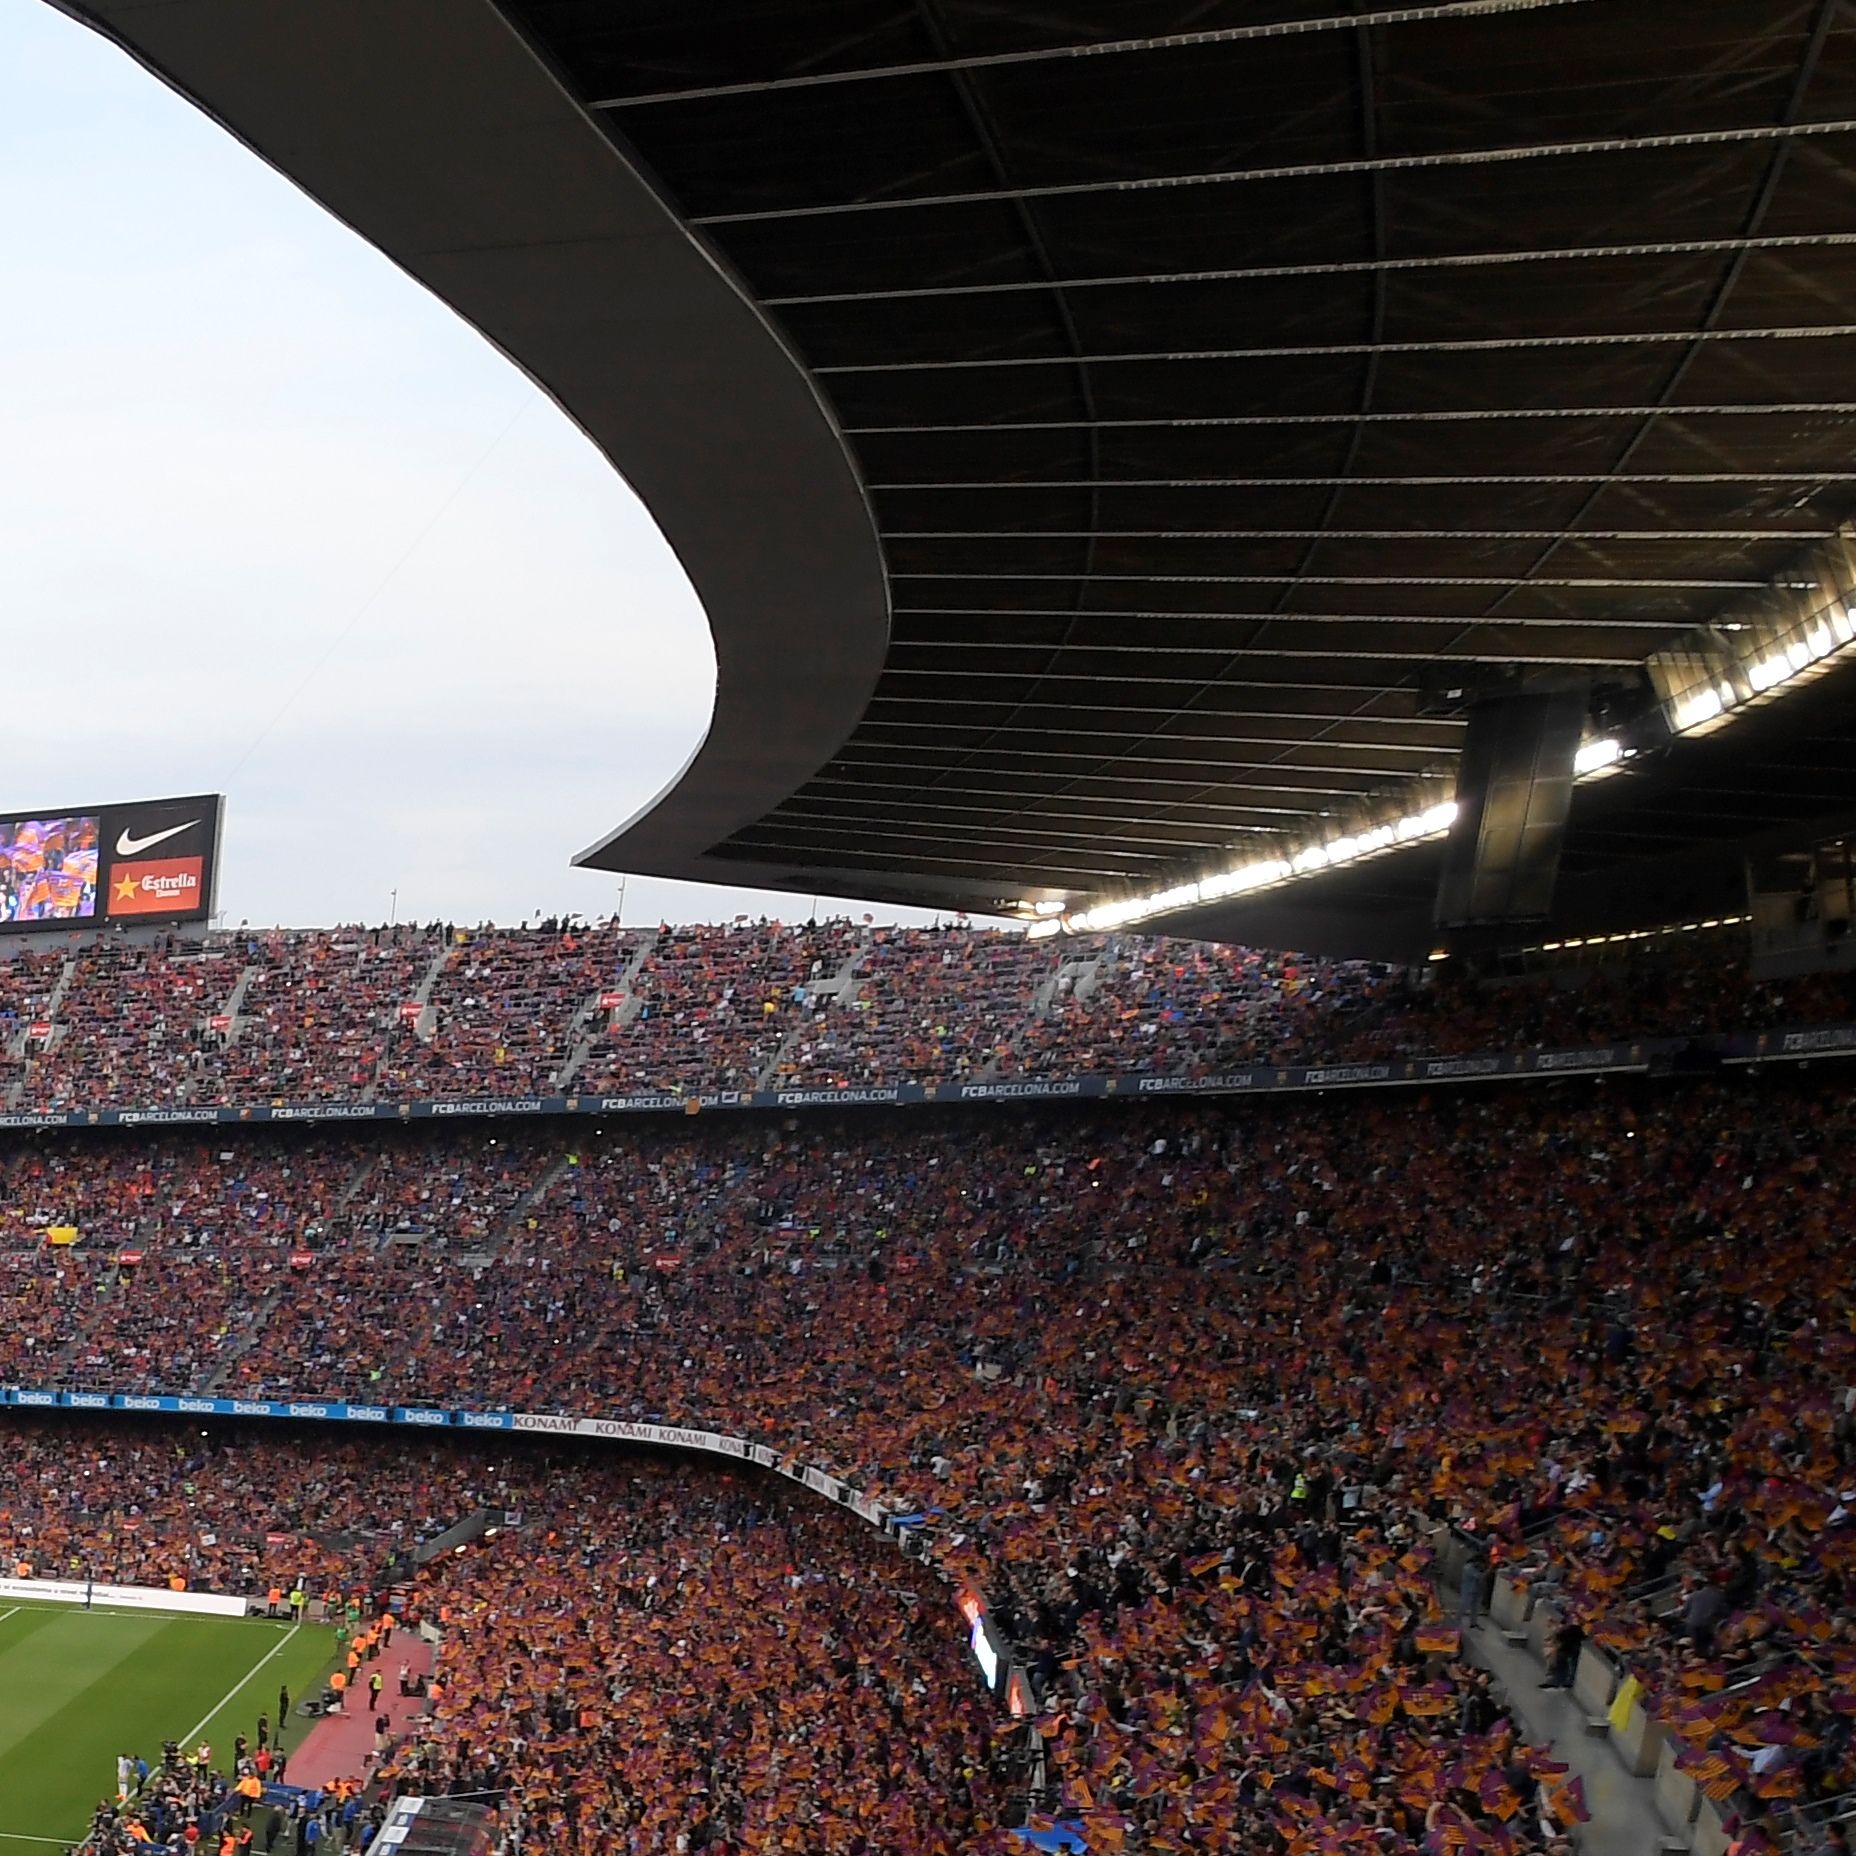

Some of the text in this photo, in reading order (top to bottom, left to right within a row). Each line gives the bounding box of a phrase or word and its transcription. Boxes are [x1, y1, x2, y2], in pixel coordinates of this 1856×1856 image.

[141, 872, 197, 891] Estrella
[777, 1089, 898, 1104] FCBARCELONA.COM
[961, 1082, 1080, 1098] FCBARCELONA.COM
[18, 1393, 52, 1404] beko
[71, 1395, 105, 1406] beko
[124, 1397, 159, 1408] beko
[179, 1399, 215, 1411] beko
[233, 1401, 270, 1414] beko
[290, 1404, 327, 1417] beko
[347, 1407, 386, 1420] beko
[403, 1410, 443, 1423] beko
[464, 1413, 503, 1427] beko
[514, 1414, 580, 1431] KONAMI
[595, 1420, 652, 1438] KONAMI
[658, 1427, 706, 1446] KONAMI
